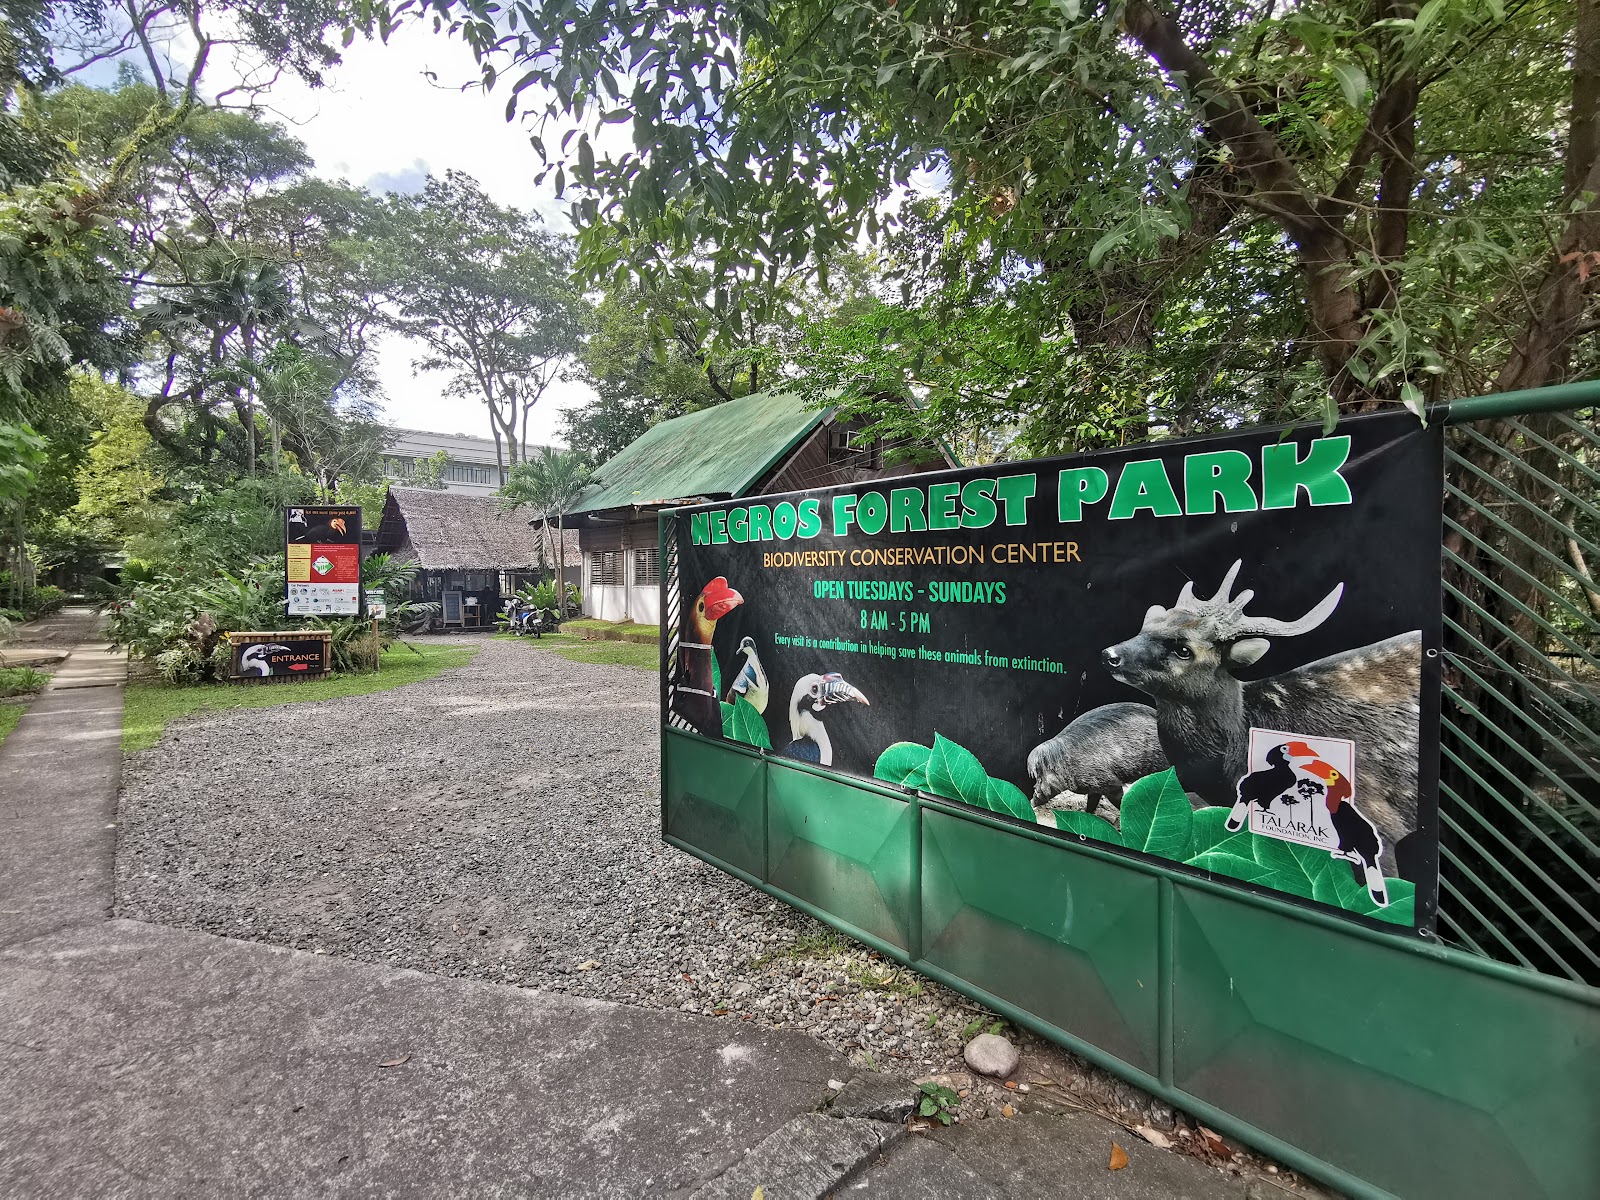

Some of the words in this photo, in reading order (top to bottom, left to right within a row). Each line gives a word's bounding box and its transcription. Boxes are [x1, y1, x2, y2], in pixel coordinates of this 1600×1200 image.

[691, 498, 822, 546] NEGROS
[832, 473, 1036, 537] FOREST
[1058, 435, 1352, 523] PARK
[763, 549, 846, 568] BIODIVERSITY
[850, 545, 984, 567] CONSERVATION
[991, 541, 1081, 564] CENTER
[813, 580, 844, 600] OPEN
[848, 580, 914, 602] TUESDAYS
[928, 581, 1006, 604] SUNDAYS
[860, 610, 867, 629] 8
[870, 611, 888, 631] AM
[899, 612, 906, 632] 5
[910, 612, 931, 634] PM
[271, 653, 320, 663] ENTRANCE
[774, 632, 791, 648] Every
[791, 634, 805, 647] visit
[805, 636, 812, 648] is
[812, 639, 818, 648] a
[819, 637, 858, 652] contribution
[860, 640, 867, 653] in
[869, 641, 896, 660] helping
[898, 647, 916, 660] save
[918, 645, 942, 661] these
[944, 650, 982, 665] animals
[984, 650, 1008, 669] from
[1011, 655, 1067, 675] extinction.
[1260, 813, 1329, 838] TALARAK
